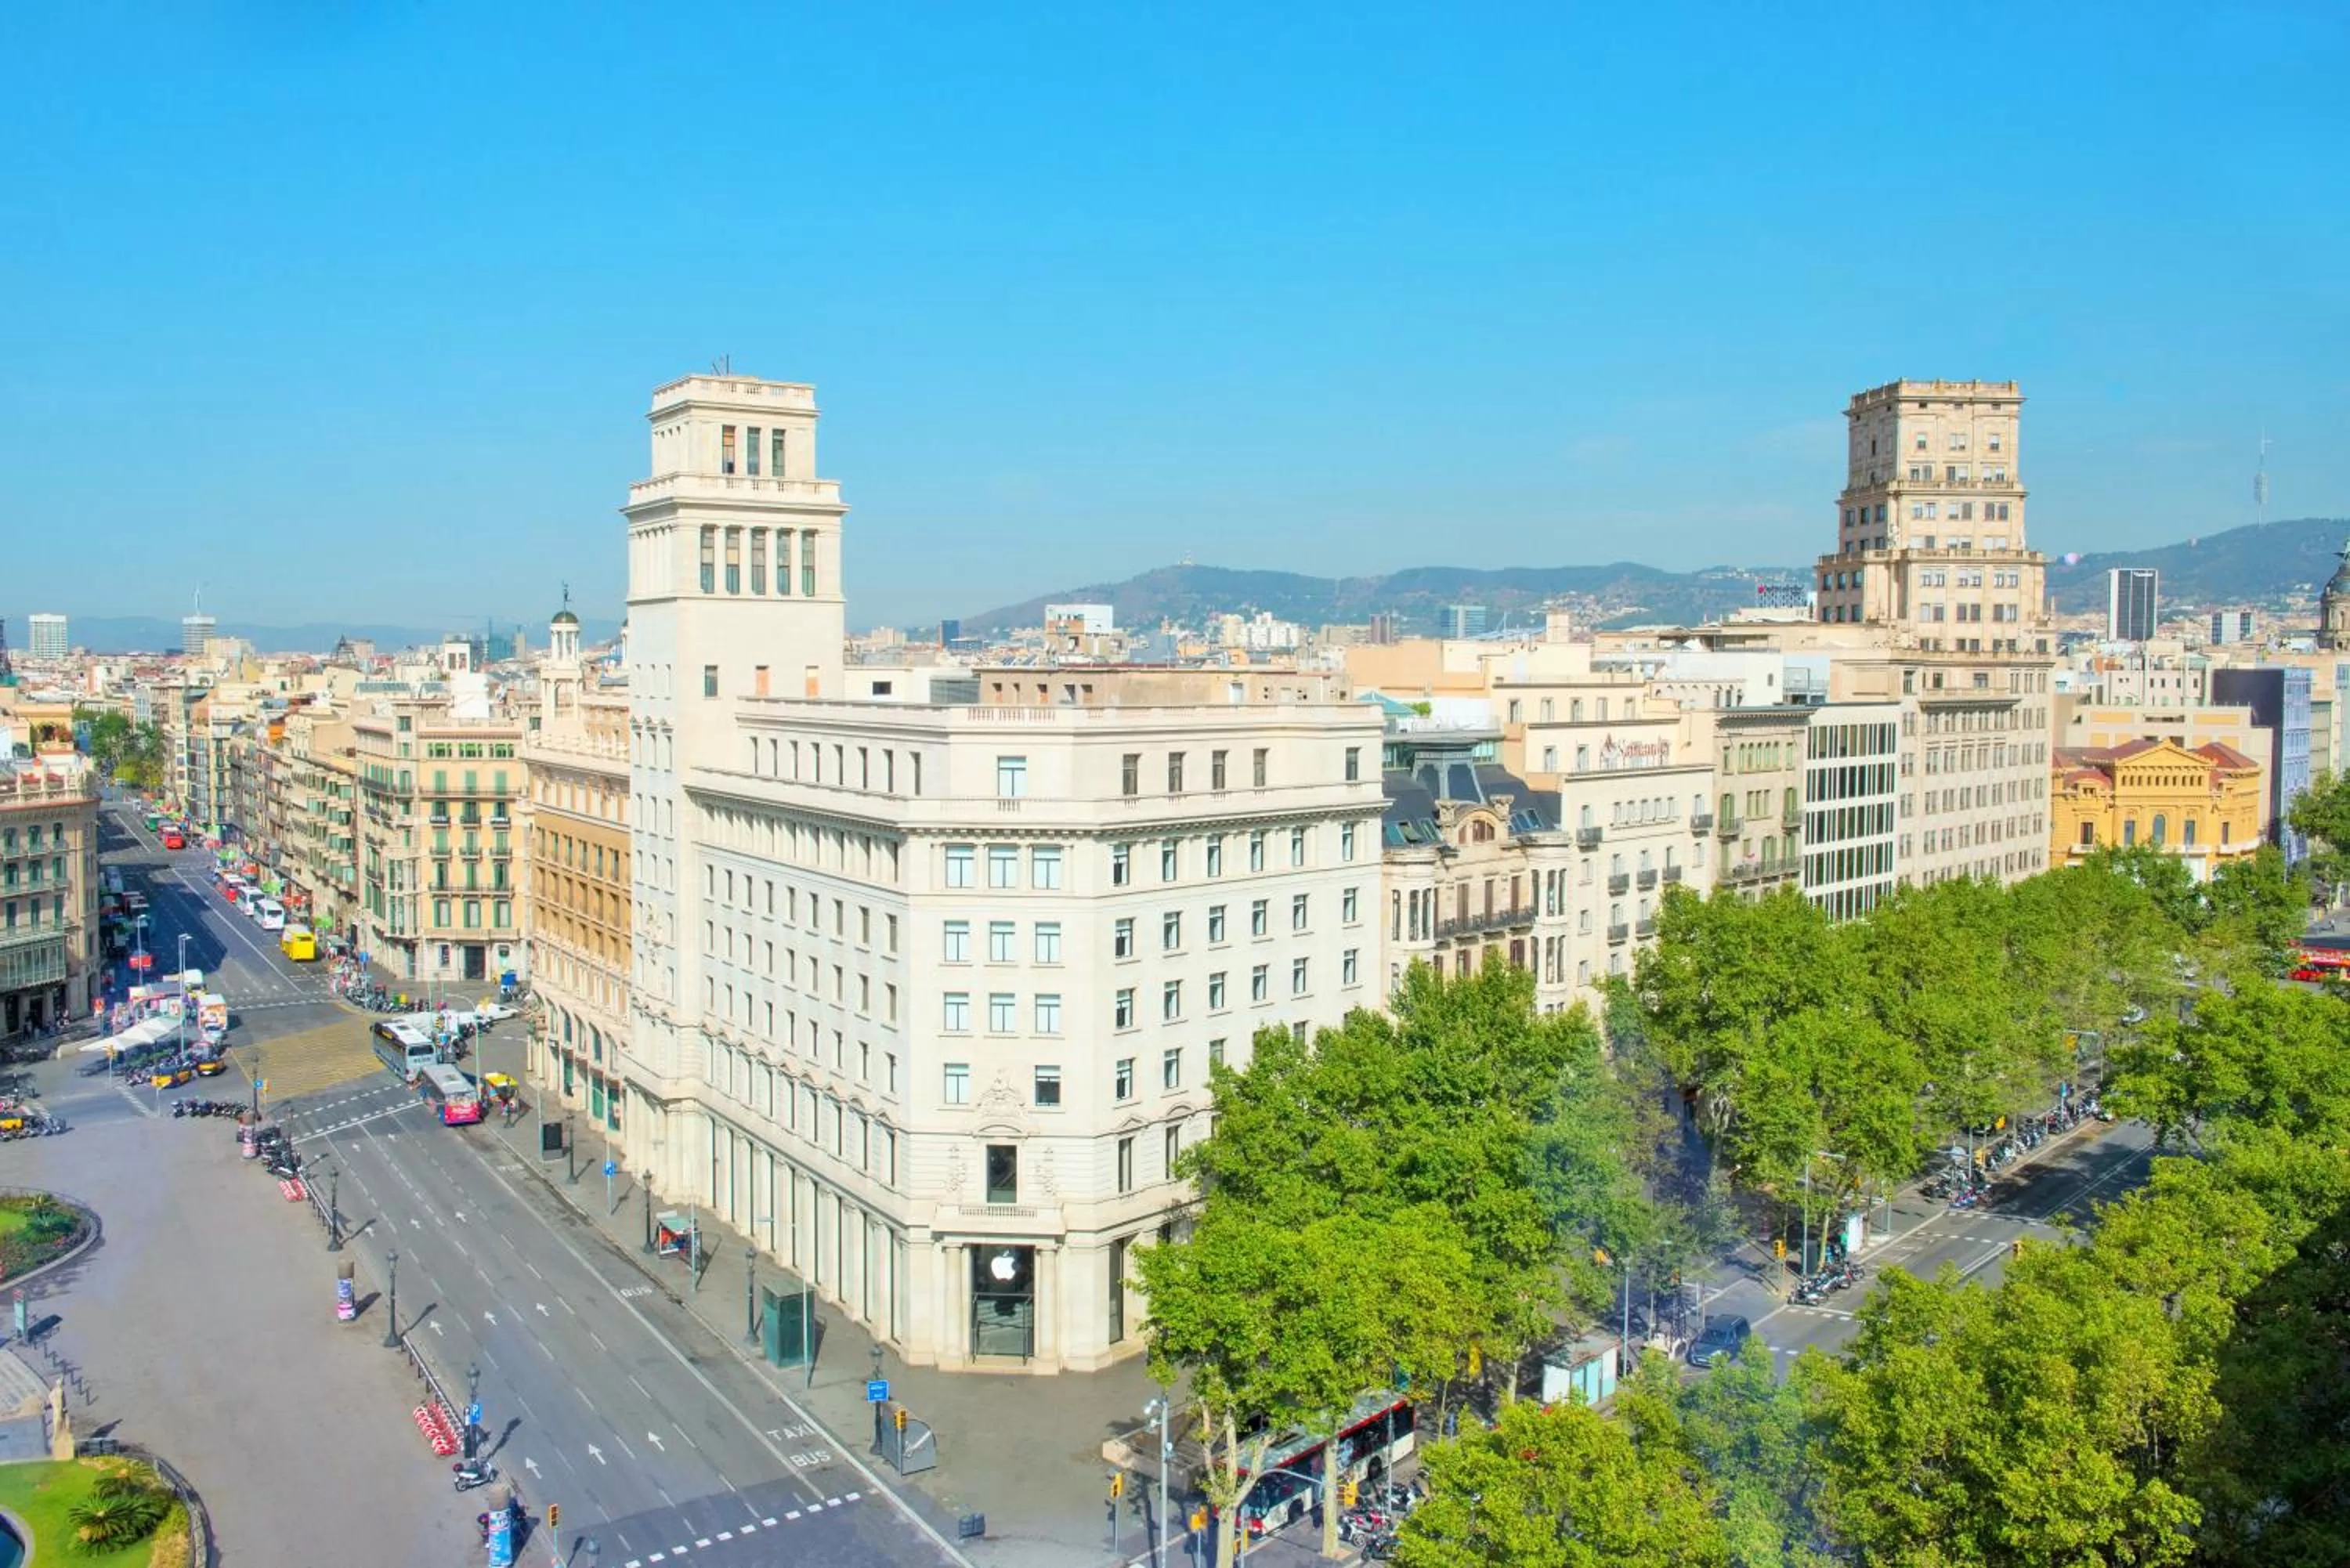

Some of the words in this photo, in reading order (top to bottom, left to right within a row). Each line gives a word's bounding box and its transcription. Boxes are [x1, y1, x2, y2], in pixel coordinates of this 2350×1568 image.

[620, 1286, 653, 1298] BUS
[766, 1422, 815, 1441] TAXI
[789, 1451, 831, 1467] BUS
